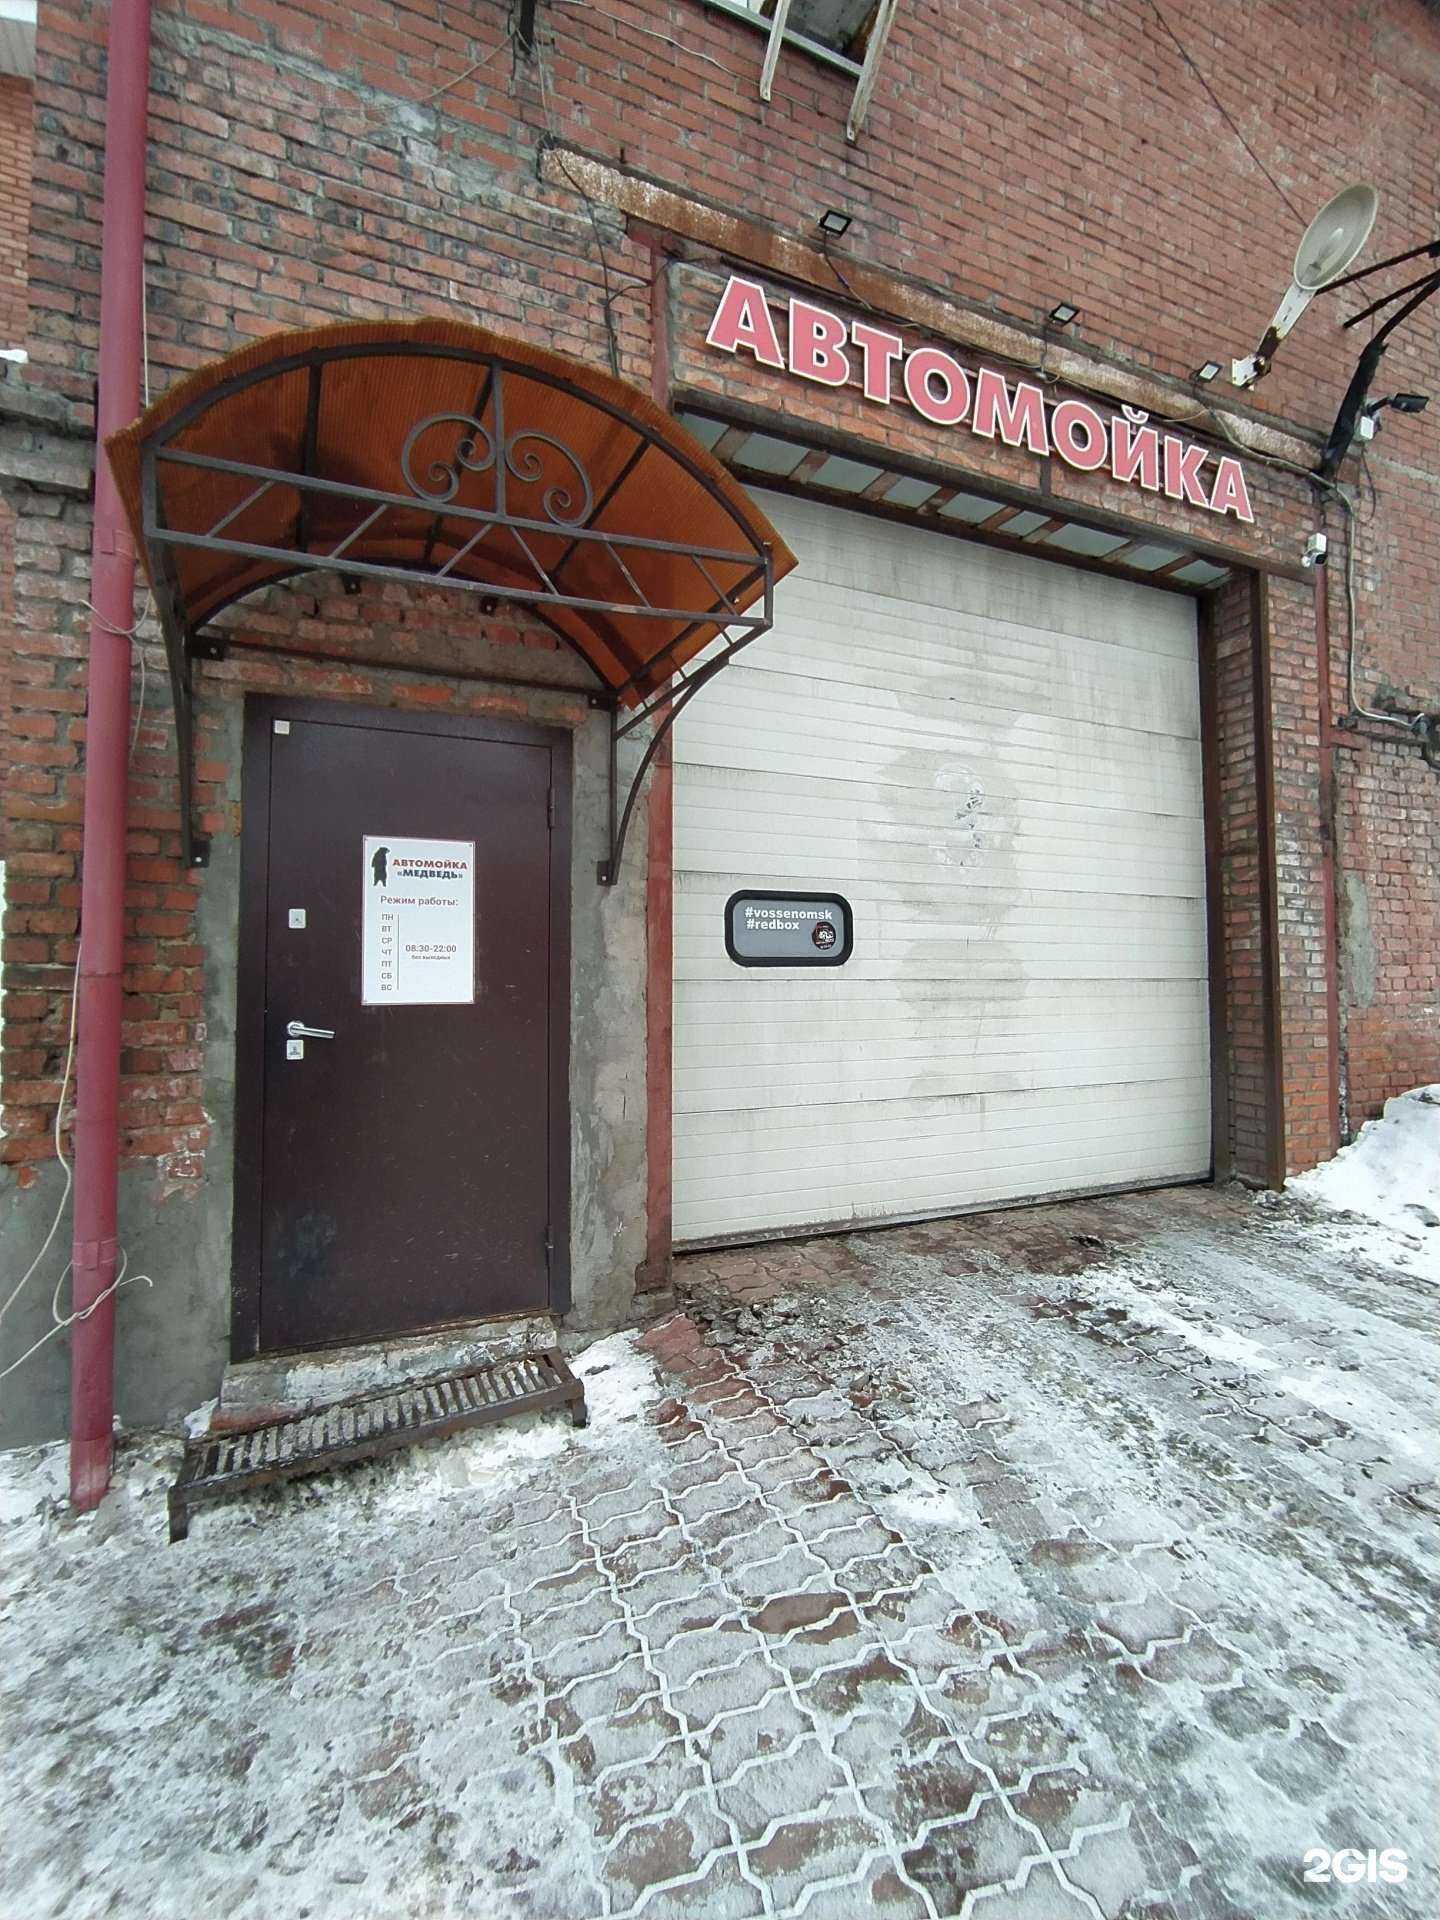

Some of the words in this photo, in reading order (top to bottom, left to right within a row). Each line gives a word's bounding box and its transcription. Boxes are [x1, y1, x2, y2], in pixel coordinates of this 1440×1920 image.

[706, 275, 1255, 523] АВТОМОЙКА
[392, 858, 467, 869] АВТОМОЙКА
[397, 869, 463, 879] «МЕДВЕДЬ»
[380, 895, 416, 905] Режим
[418, 896, 459, 907] работы:
[381, 913, 394, 921] ПН
[745, 906, 832, 919] #vossenomsk
[381, 925, 392, 933] ВТ
[746, 919, 799, 929] #redbox
[405, 944, 457, 953] 08:30-22:00
[381, 960, 392, 968] ПТ
[381, 972, 393, 980] СБ
